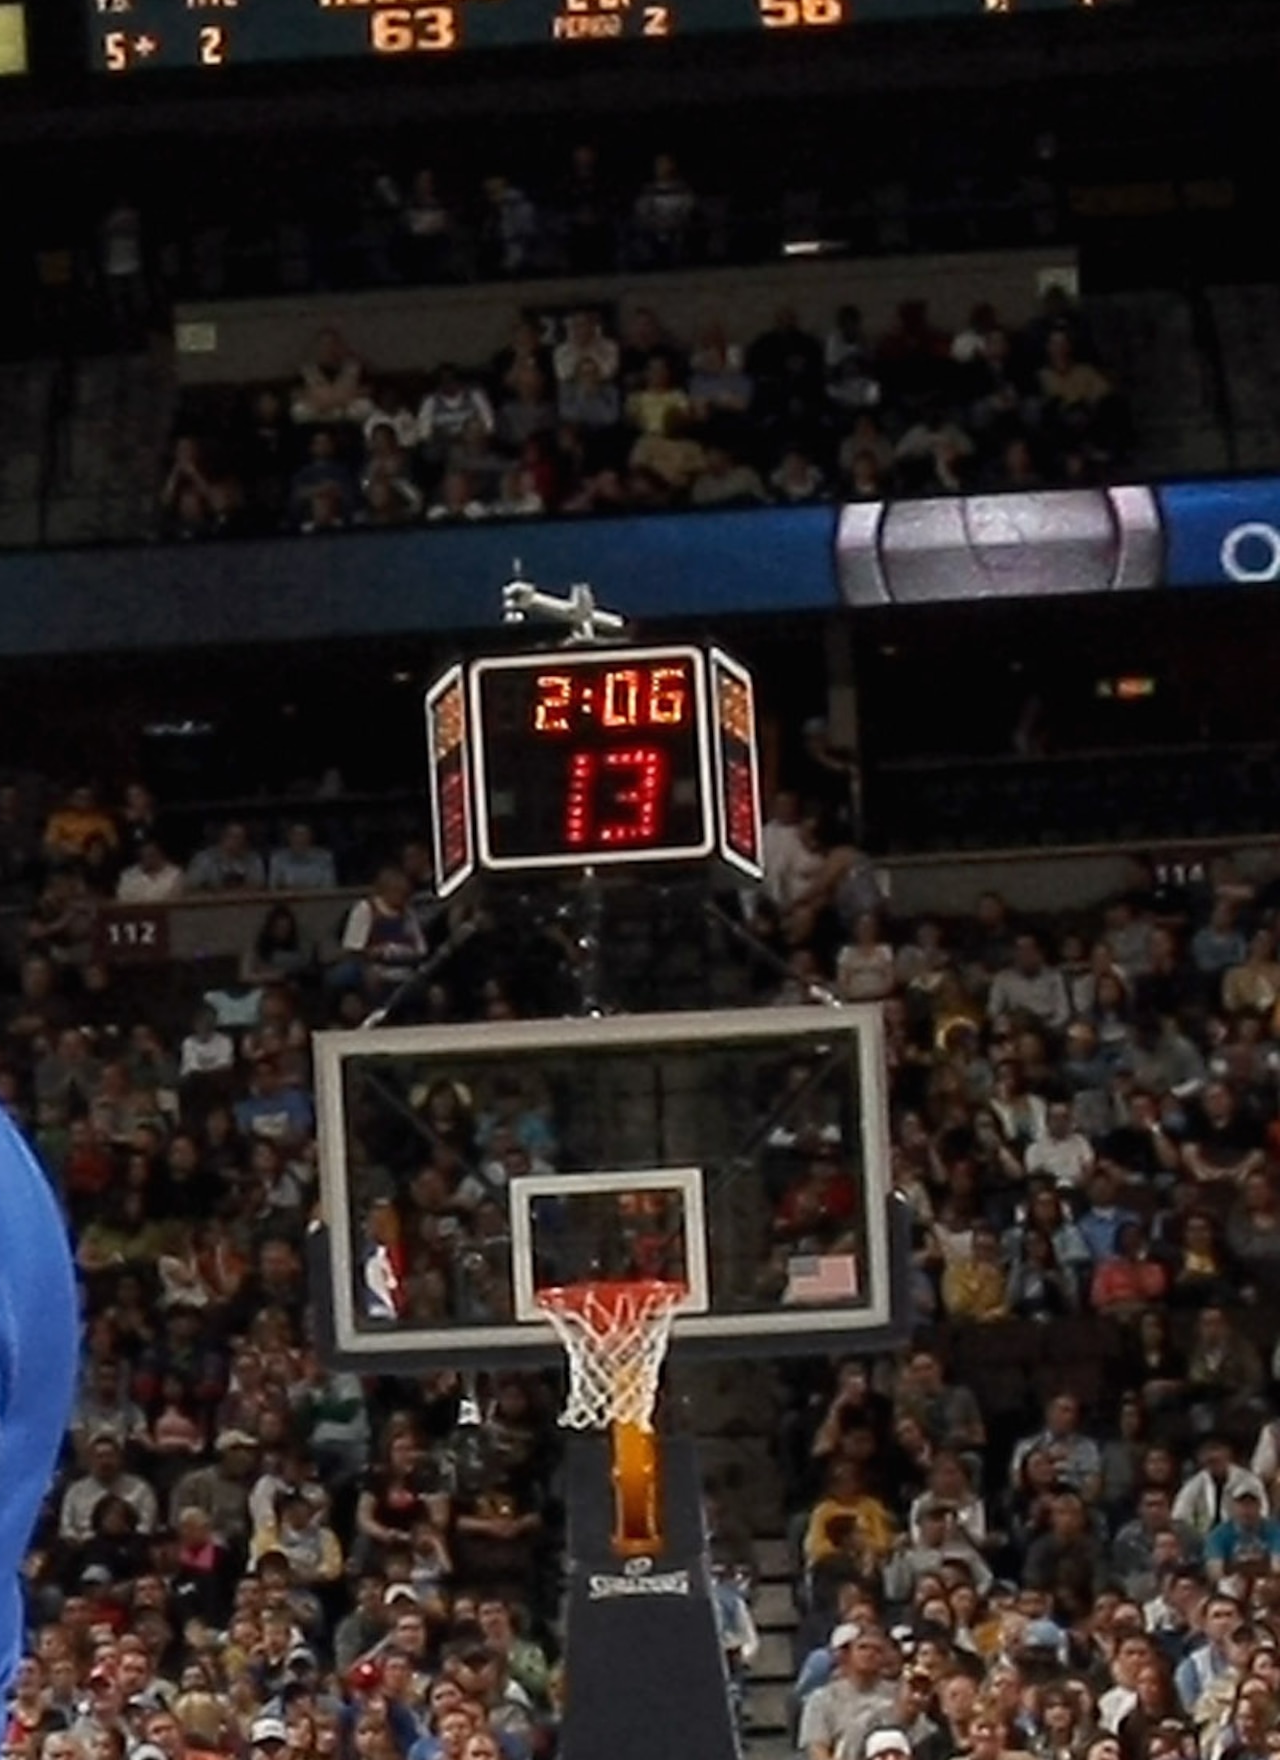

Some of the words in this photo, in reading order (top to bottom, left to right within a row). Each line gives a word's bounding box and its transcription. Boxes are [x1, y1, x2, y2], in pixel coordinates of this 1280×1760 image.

[371, 6, 456, 52] 63
[643, 5, 669, 36] 2
[199, 26, 223, 65] 2
[534, 666, 687, 731] 2:06
[565, 749, 660, 843] 13
[108, 921, 157, 945] 112
